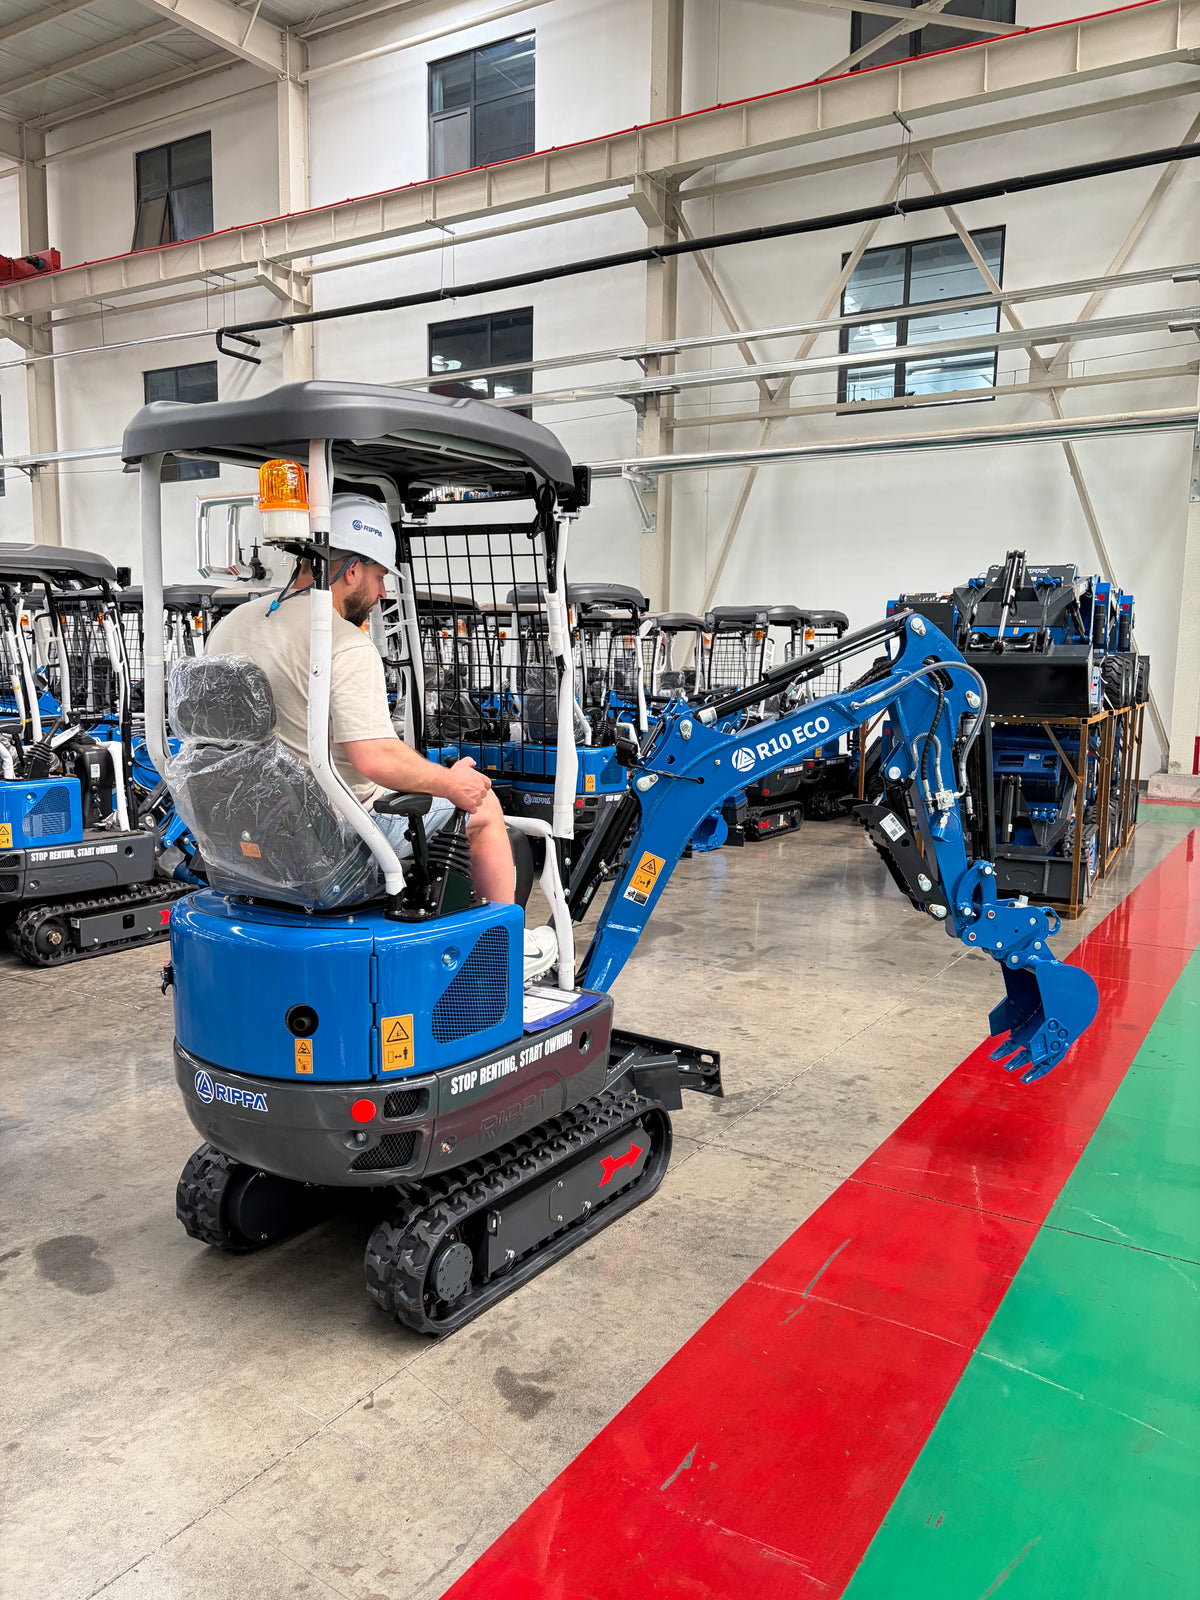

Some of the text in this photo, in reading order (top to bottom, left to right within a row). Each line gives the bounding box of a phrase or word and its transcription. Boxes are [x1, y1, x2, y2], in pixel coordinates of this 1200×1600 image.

[363, 525, 382, 538] RIPPA
[756, 716, 830, 761] R10 ECO
[30, 844, 118, 862] STOP RENTING, START OWNING
[450, 1029, 573, 1095] STOP RENTING, START OWNING
